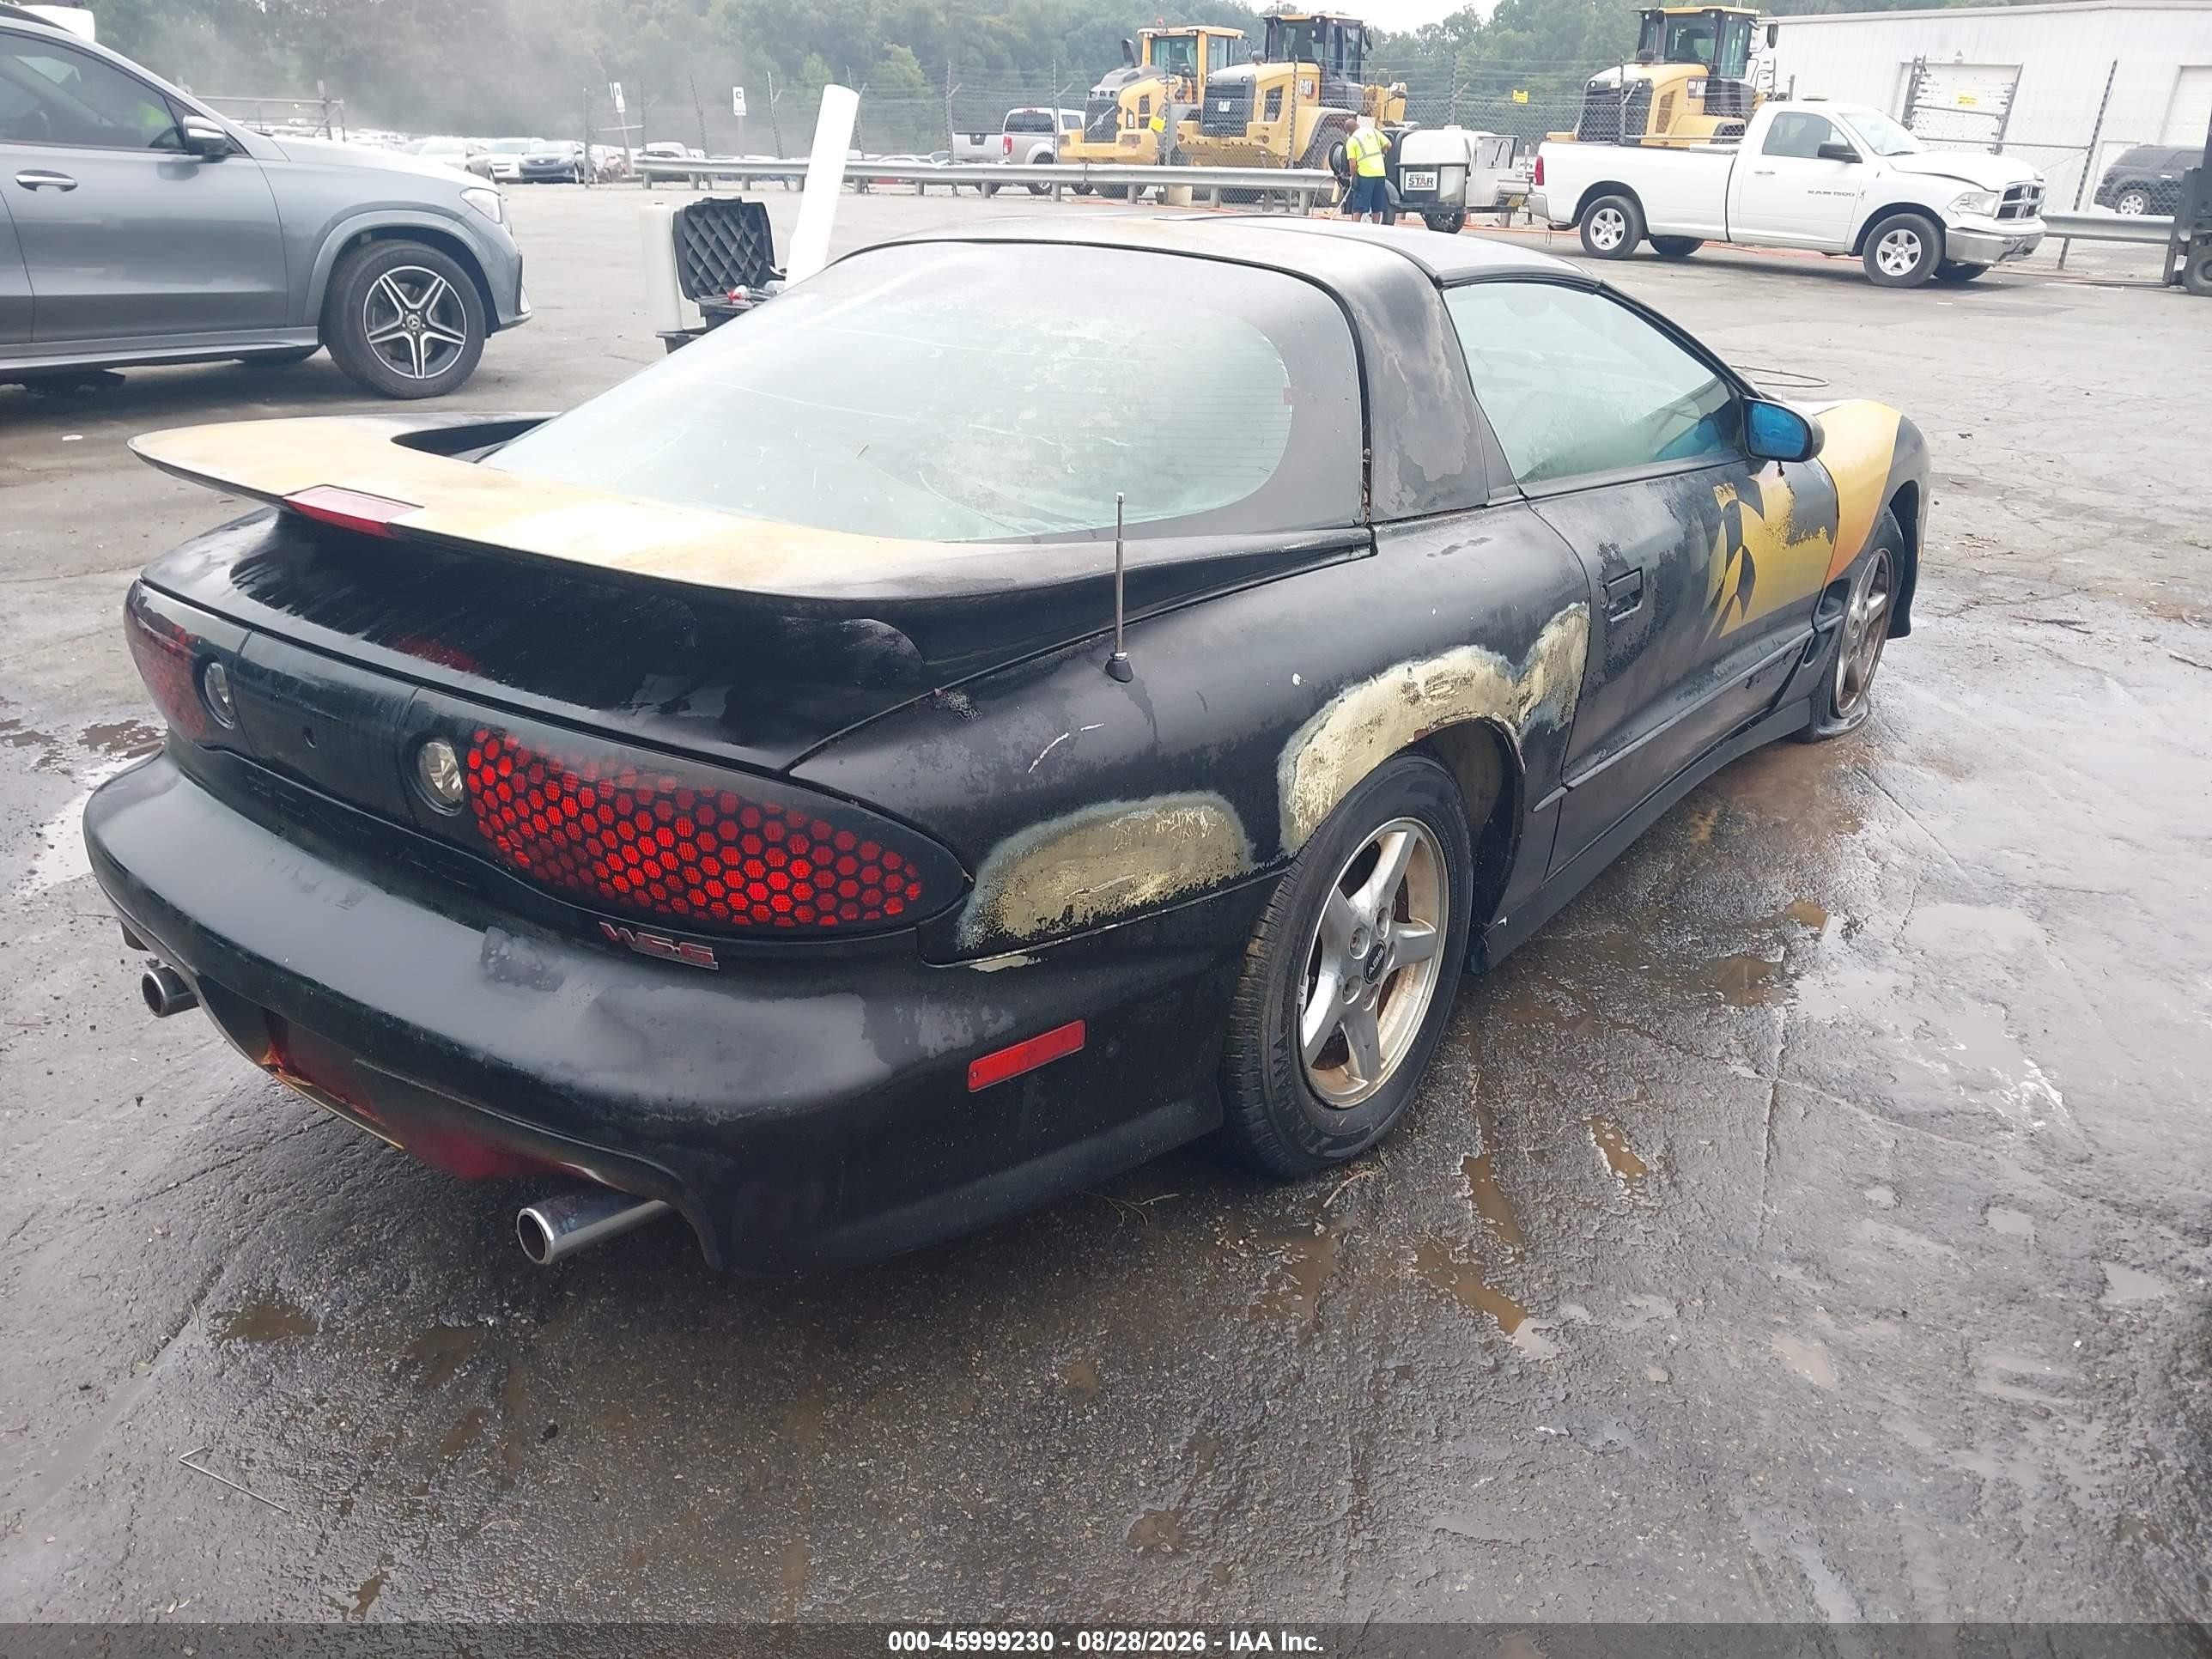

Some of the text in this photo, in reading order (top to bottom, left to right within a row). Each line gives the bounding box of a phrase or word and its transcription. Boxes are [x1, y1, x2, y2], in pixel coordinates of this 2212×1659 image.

[1298, 79, 1313, 95] CAT
[735, 91, 743, 100] C
[1218, 100, 1231, 112] CAT
[1408, 177, 1434, 185] STAR
